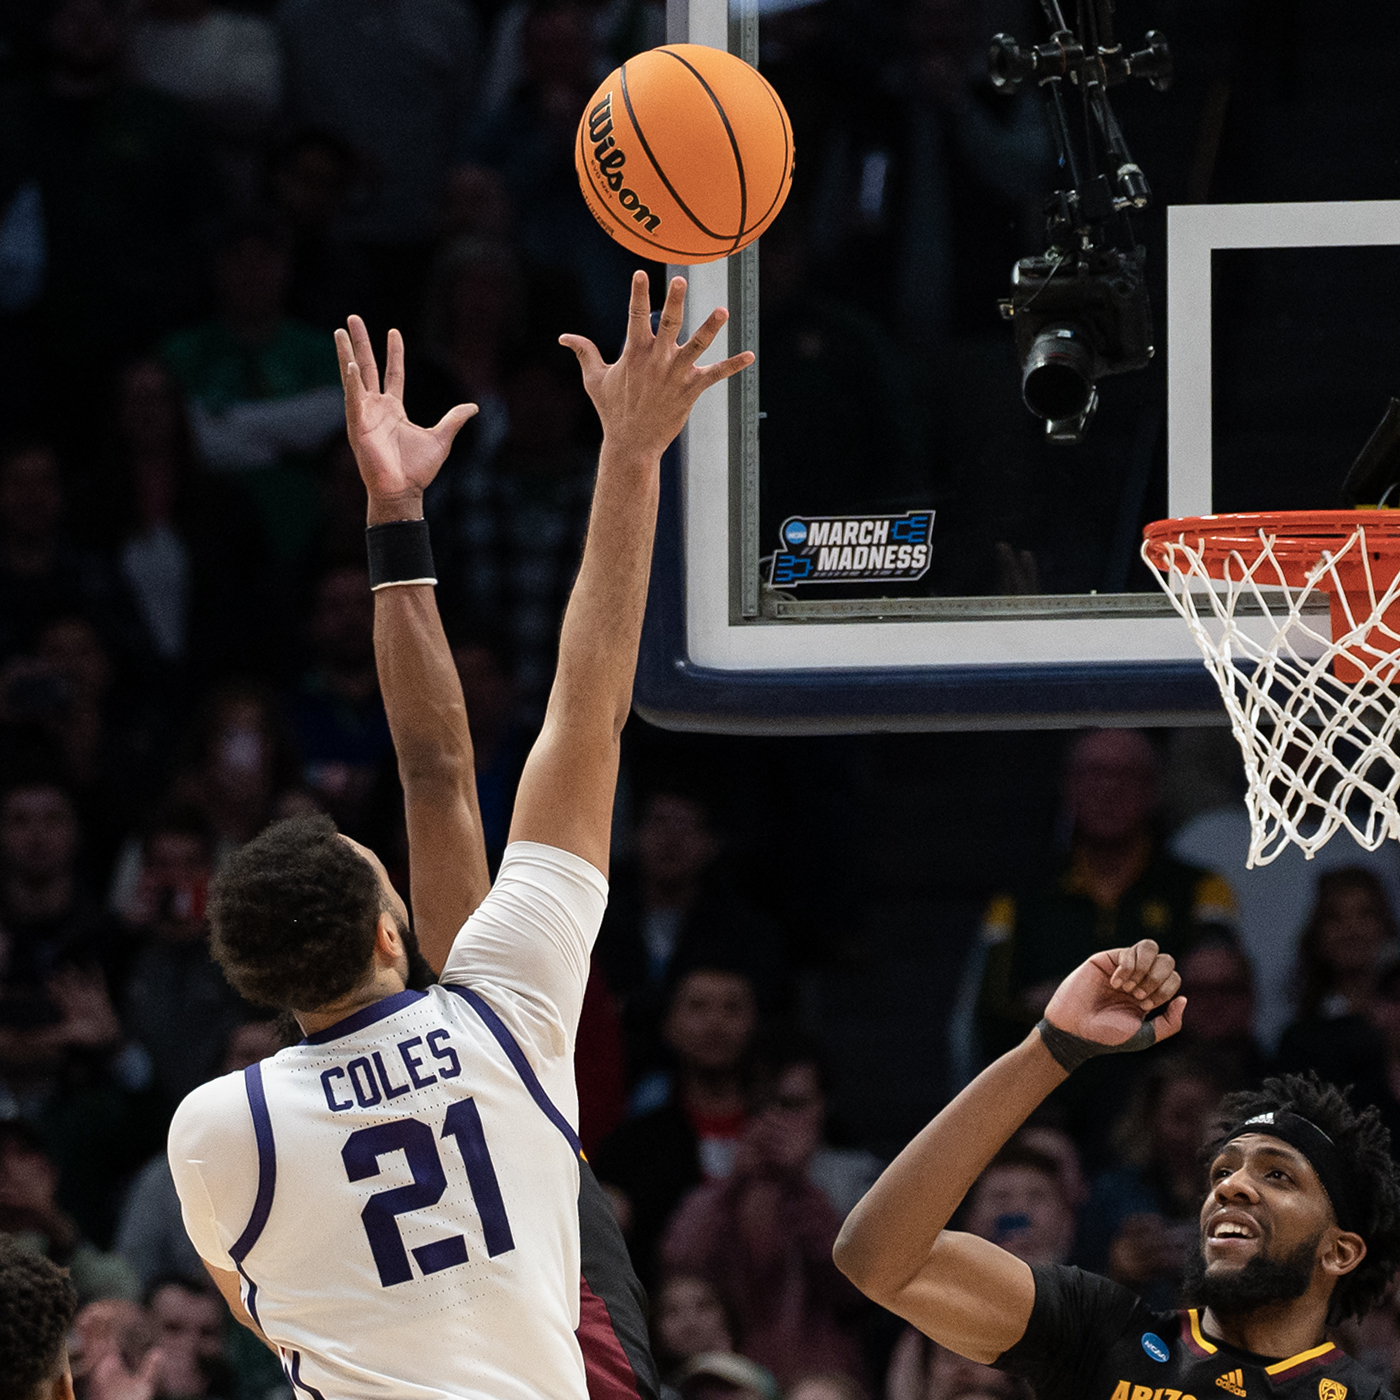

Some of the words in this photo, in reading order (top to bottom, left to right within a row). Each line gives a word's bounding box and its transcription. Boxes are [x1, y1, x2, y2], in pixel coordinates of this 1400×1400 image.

[588, 90, 662, 234] Wilson
[808, 520, 890, 546] MARCH
[817, 546, 927, 571] MADNESS
[320, 1028, 462, 1112] COLES
[341, 1096, 516, 1288] 21
[1144, 1340, 1167, 1361] NCAA
[1215, 1378, 1247, 1398] adidas
